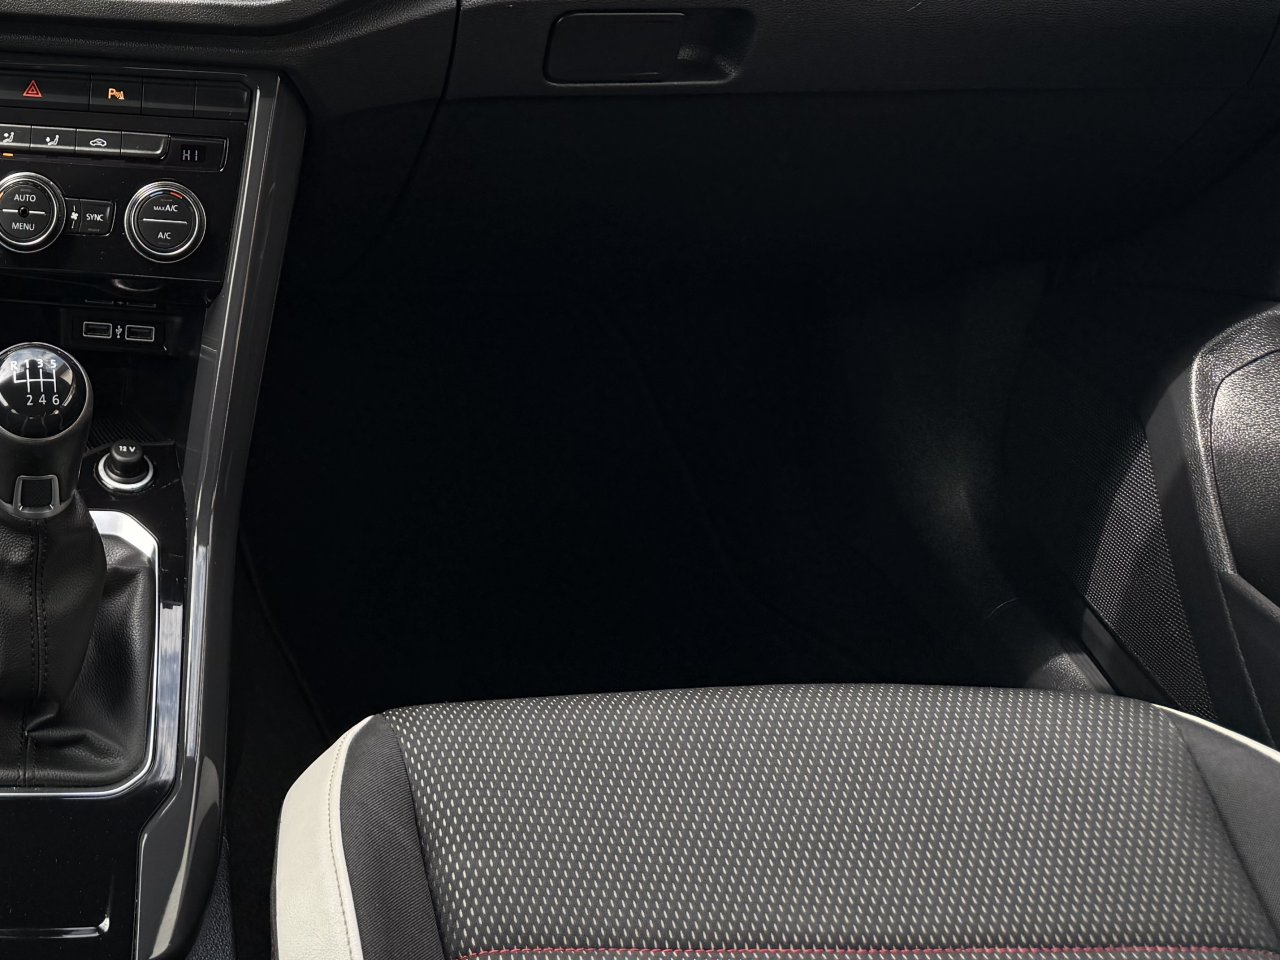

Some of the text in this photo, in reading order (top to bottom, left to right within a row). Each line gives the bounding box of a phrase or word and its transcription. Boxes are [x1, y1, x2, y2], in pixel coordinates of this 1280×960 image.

[14, 193, 37, 203] AUTO
[86, 213, 105, 222] SYNC
[12, 221, 36, 231] MENU
[157, 231, 172, 240] A/C
[10, 358, 57, 371] R 1 3 5
[26, 394, 60, 406] 2 4 6
